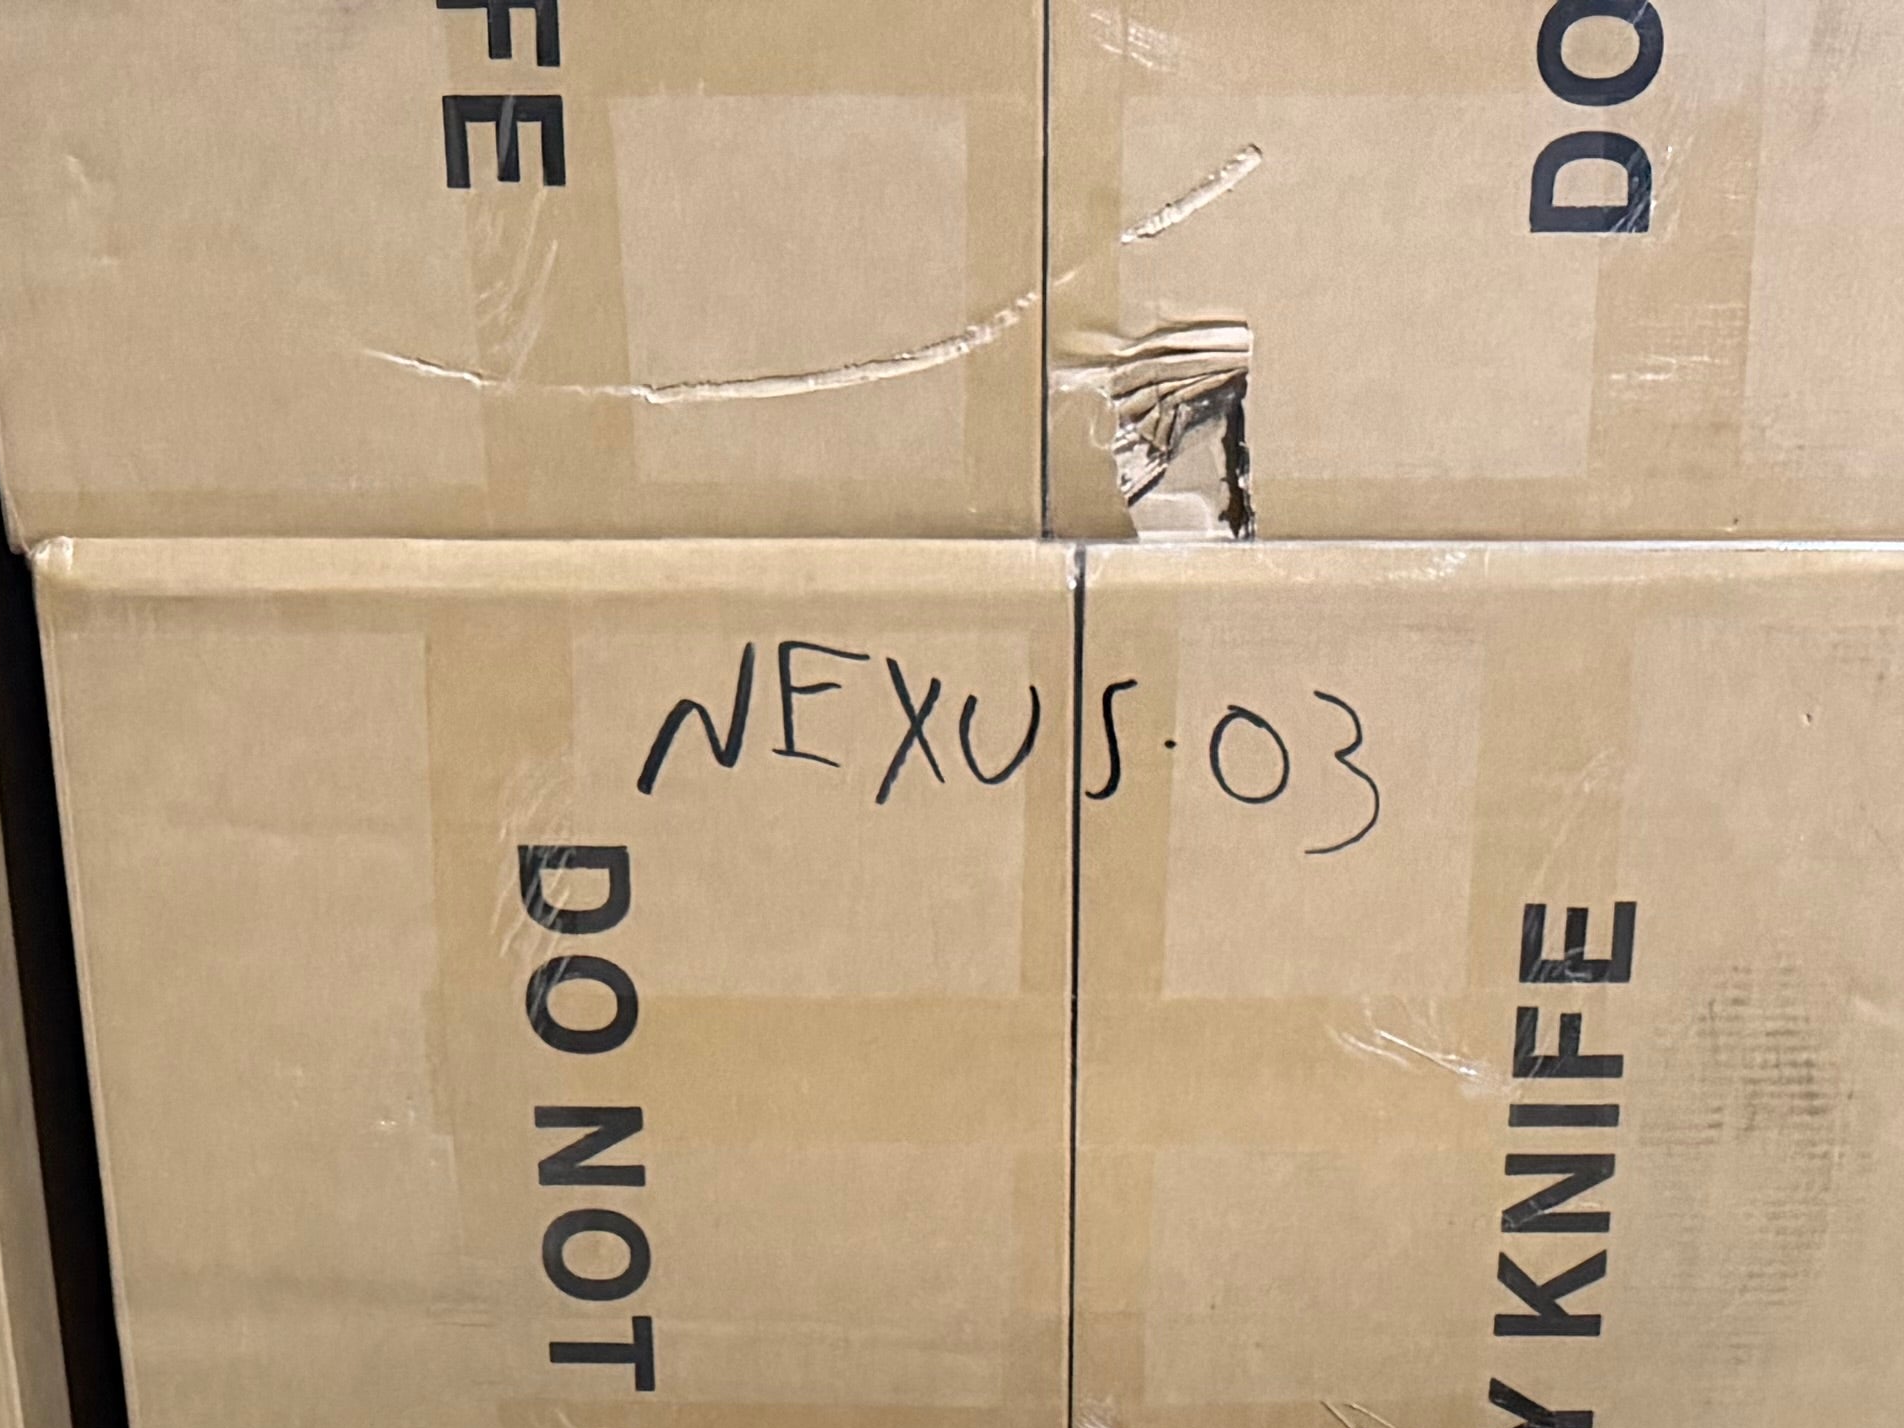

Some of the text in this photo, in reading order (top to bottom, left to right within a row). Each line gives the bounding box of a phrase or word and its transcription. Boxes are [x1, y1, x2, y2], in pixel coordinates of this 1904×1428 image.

[1528, 0, 1665, 234] DO
[516, 843, 640, 1056] DO
[533, 1105, 657, 1393] NOT
[1492, 900, 1638, 1338] KNIFE
